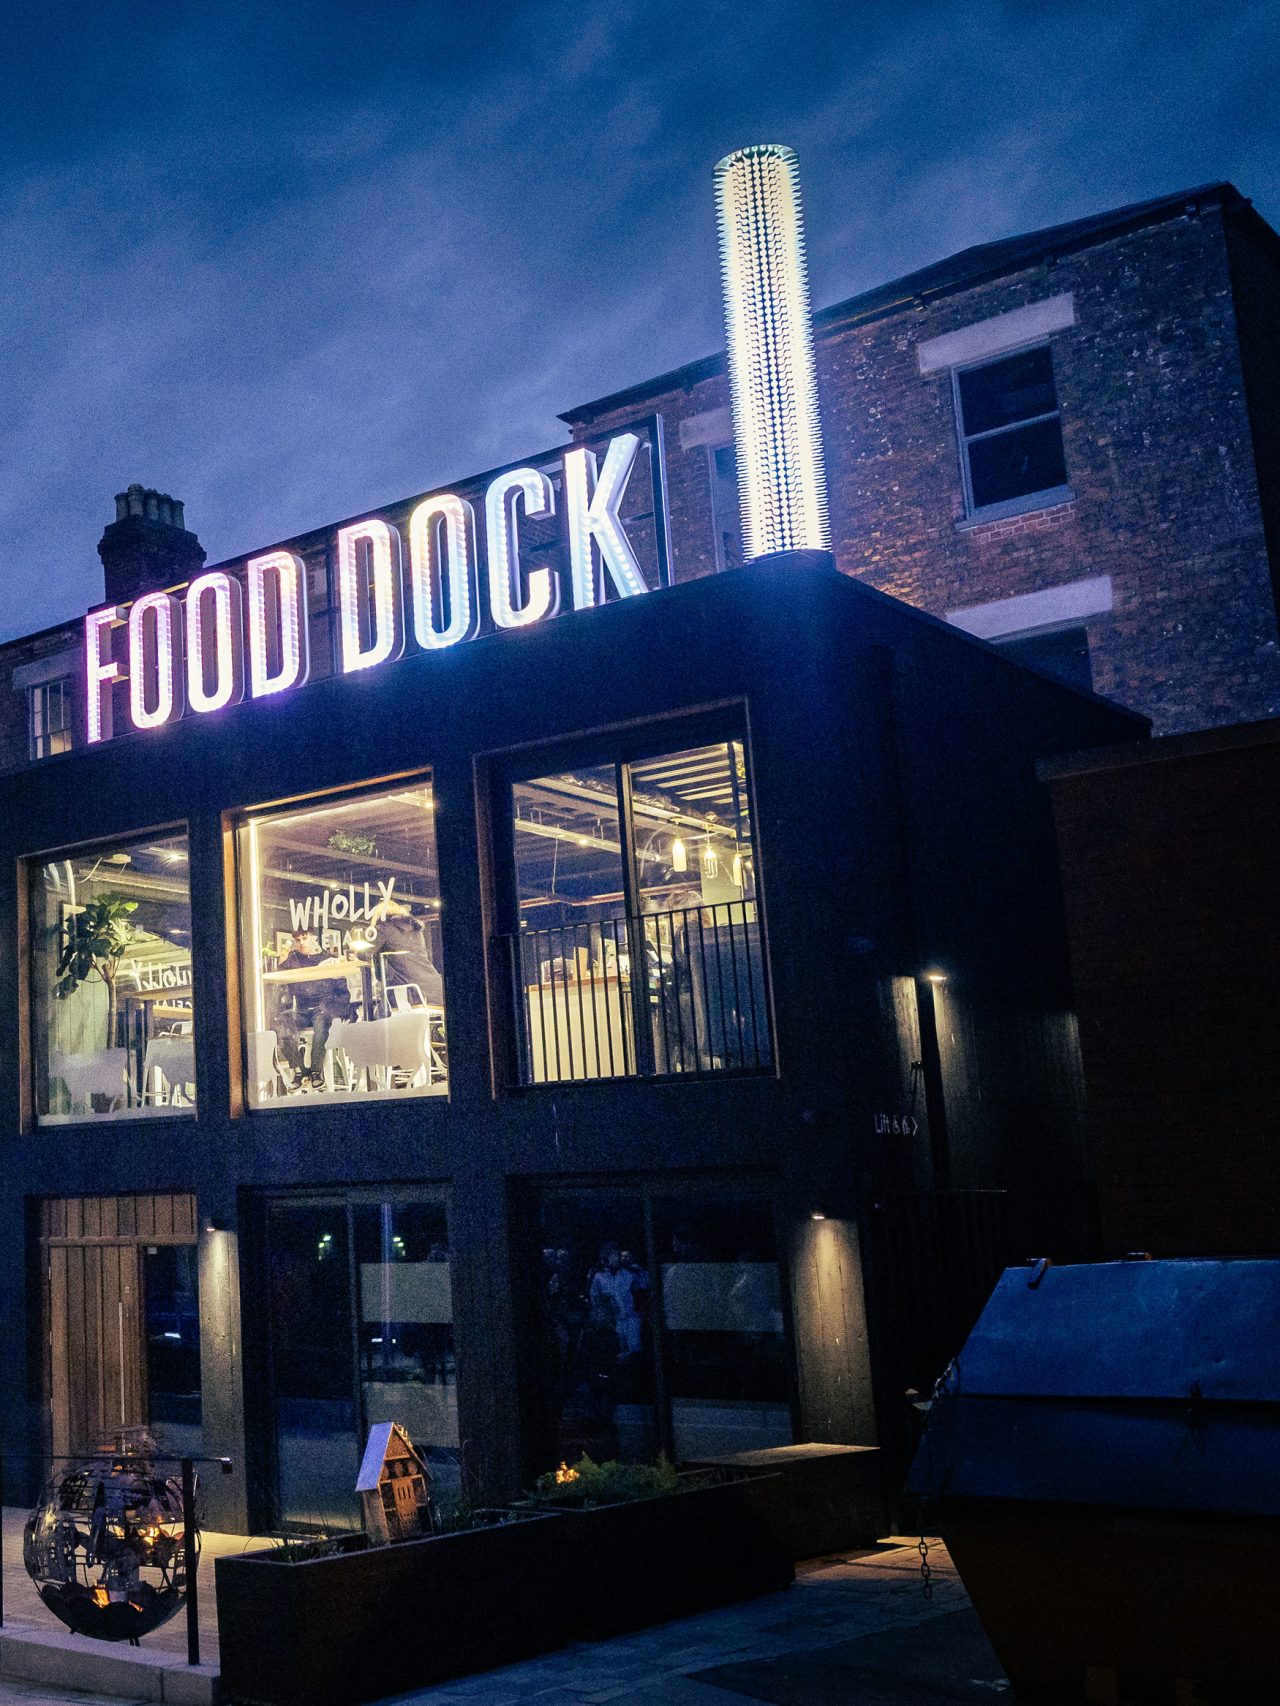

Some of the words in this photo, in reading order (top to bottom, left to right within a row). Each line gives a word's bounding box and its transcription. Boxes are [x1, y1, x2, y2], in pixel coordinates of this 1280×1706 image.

[84, 551, 308, 744] FOOD
[338, 433, 650, 673] DOCK
[289, 876, 396, 931] WHOLLY
